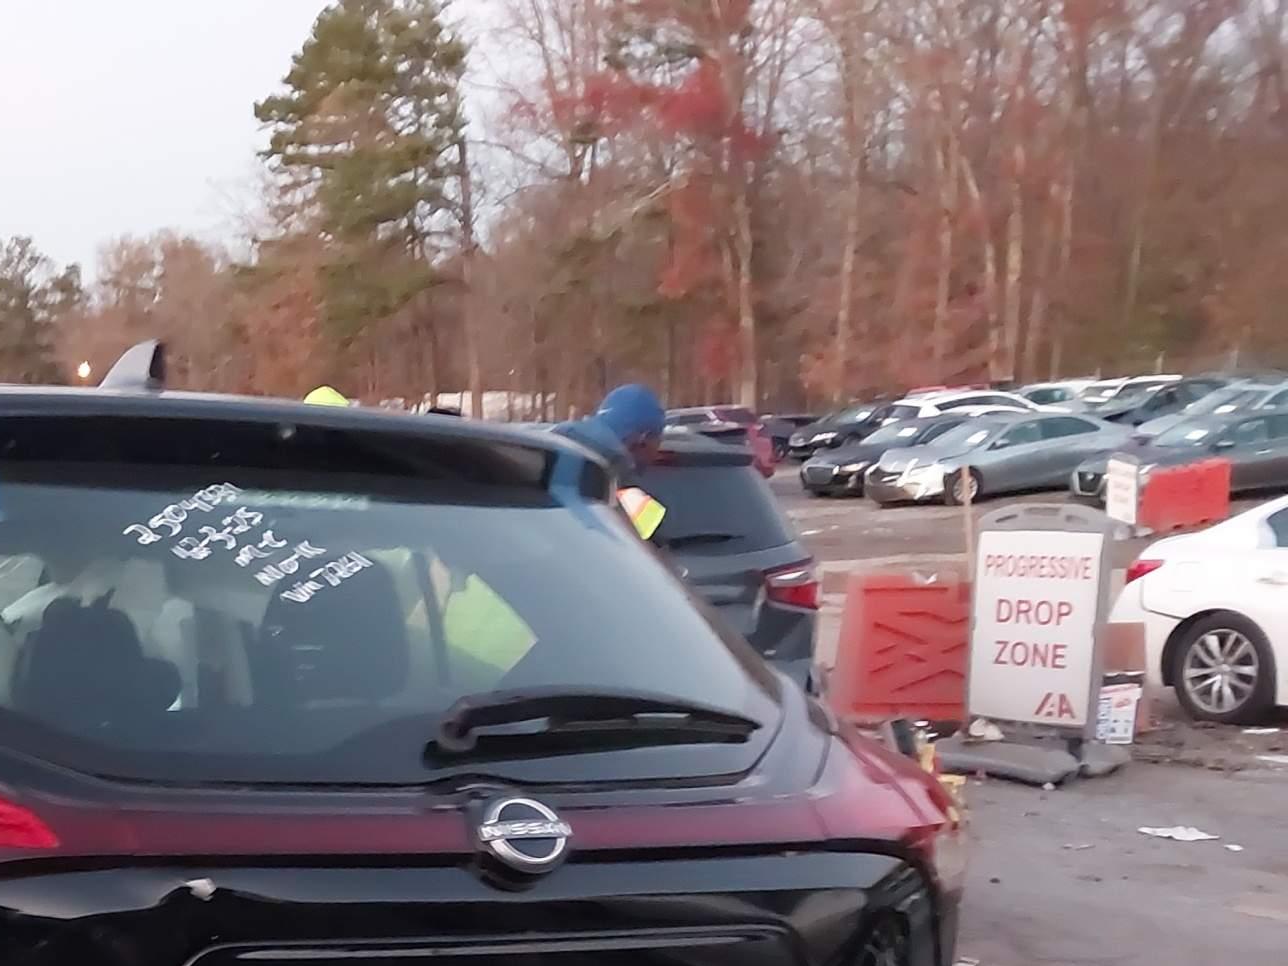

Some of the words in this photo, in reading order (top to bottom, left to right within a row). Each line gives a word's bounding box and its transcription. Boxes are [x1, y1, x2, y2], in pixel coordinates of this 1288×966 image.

[985, 554, 1093, 580] PROGRESSIVE
[996, 598, 1073, 626] DROP
[993, 640, 1068, 669] ZONE
